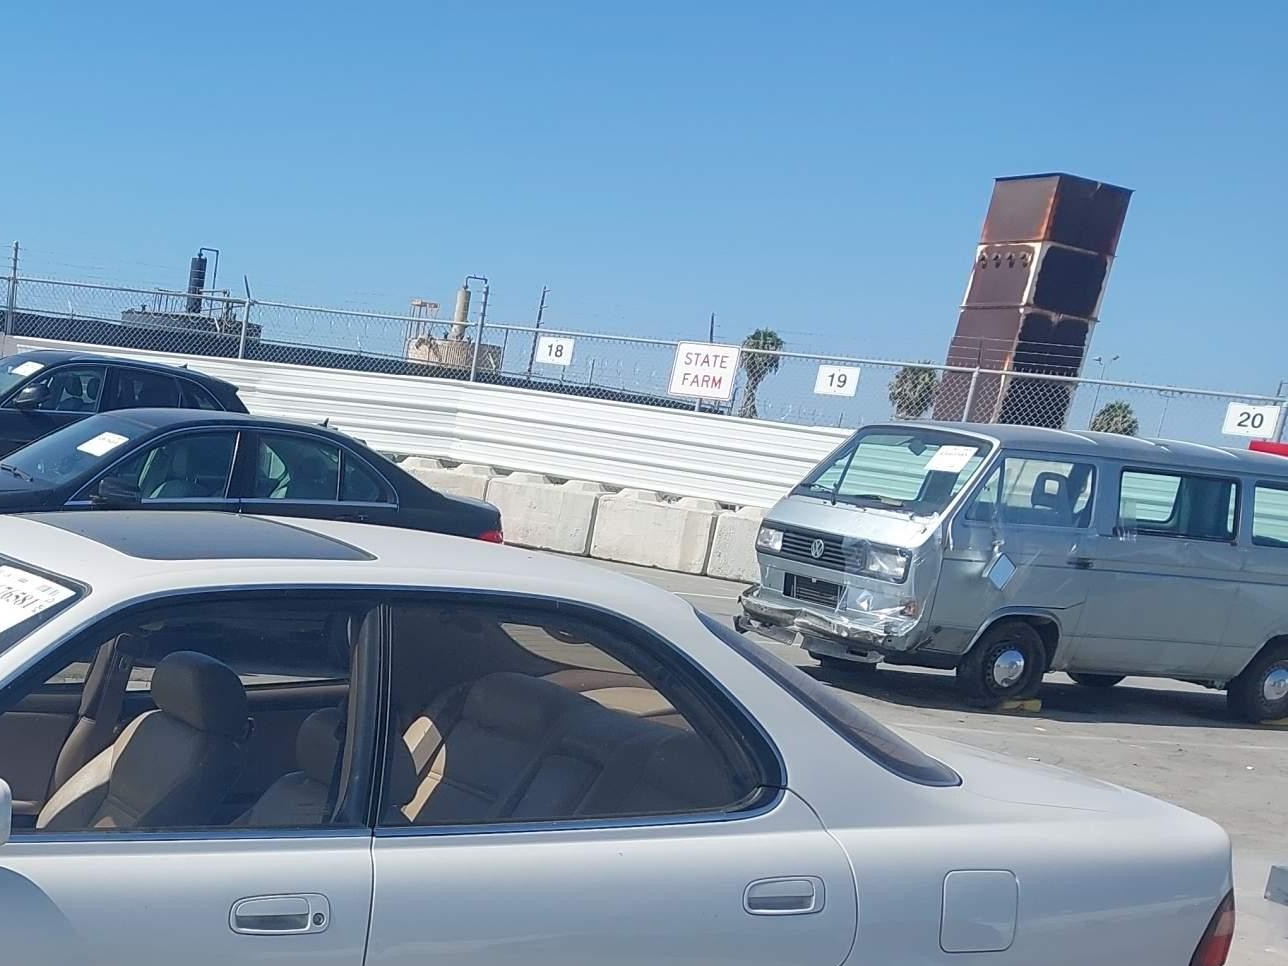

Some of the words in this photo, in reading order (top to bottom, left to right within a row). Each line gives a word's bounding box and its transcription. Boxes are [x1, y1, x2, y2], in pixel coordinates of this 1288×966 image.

[547, 343, 564, 358] 18
[684, 351, 730, 369] STATE
[681, 372, 723, 390] FARM
[827, 372, 848, 389] 19
[1236, 411, 1264, 429] 20
